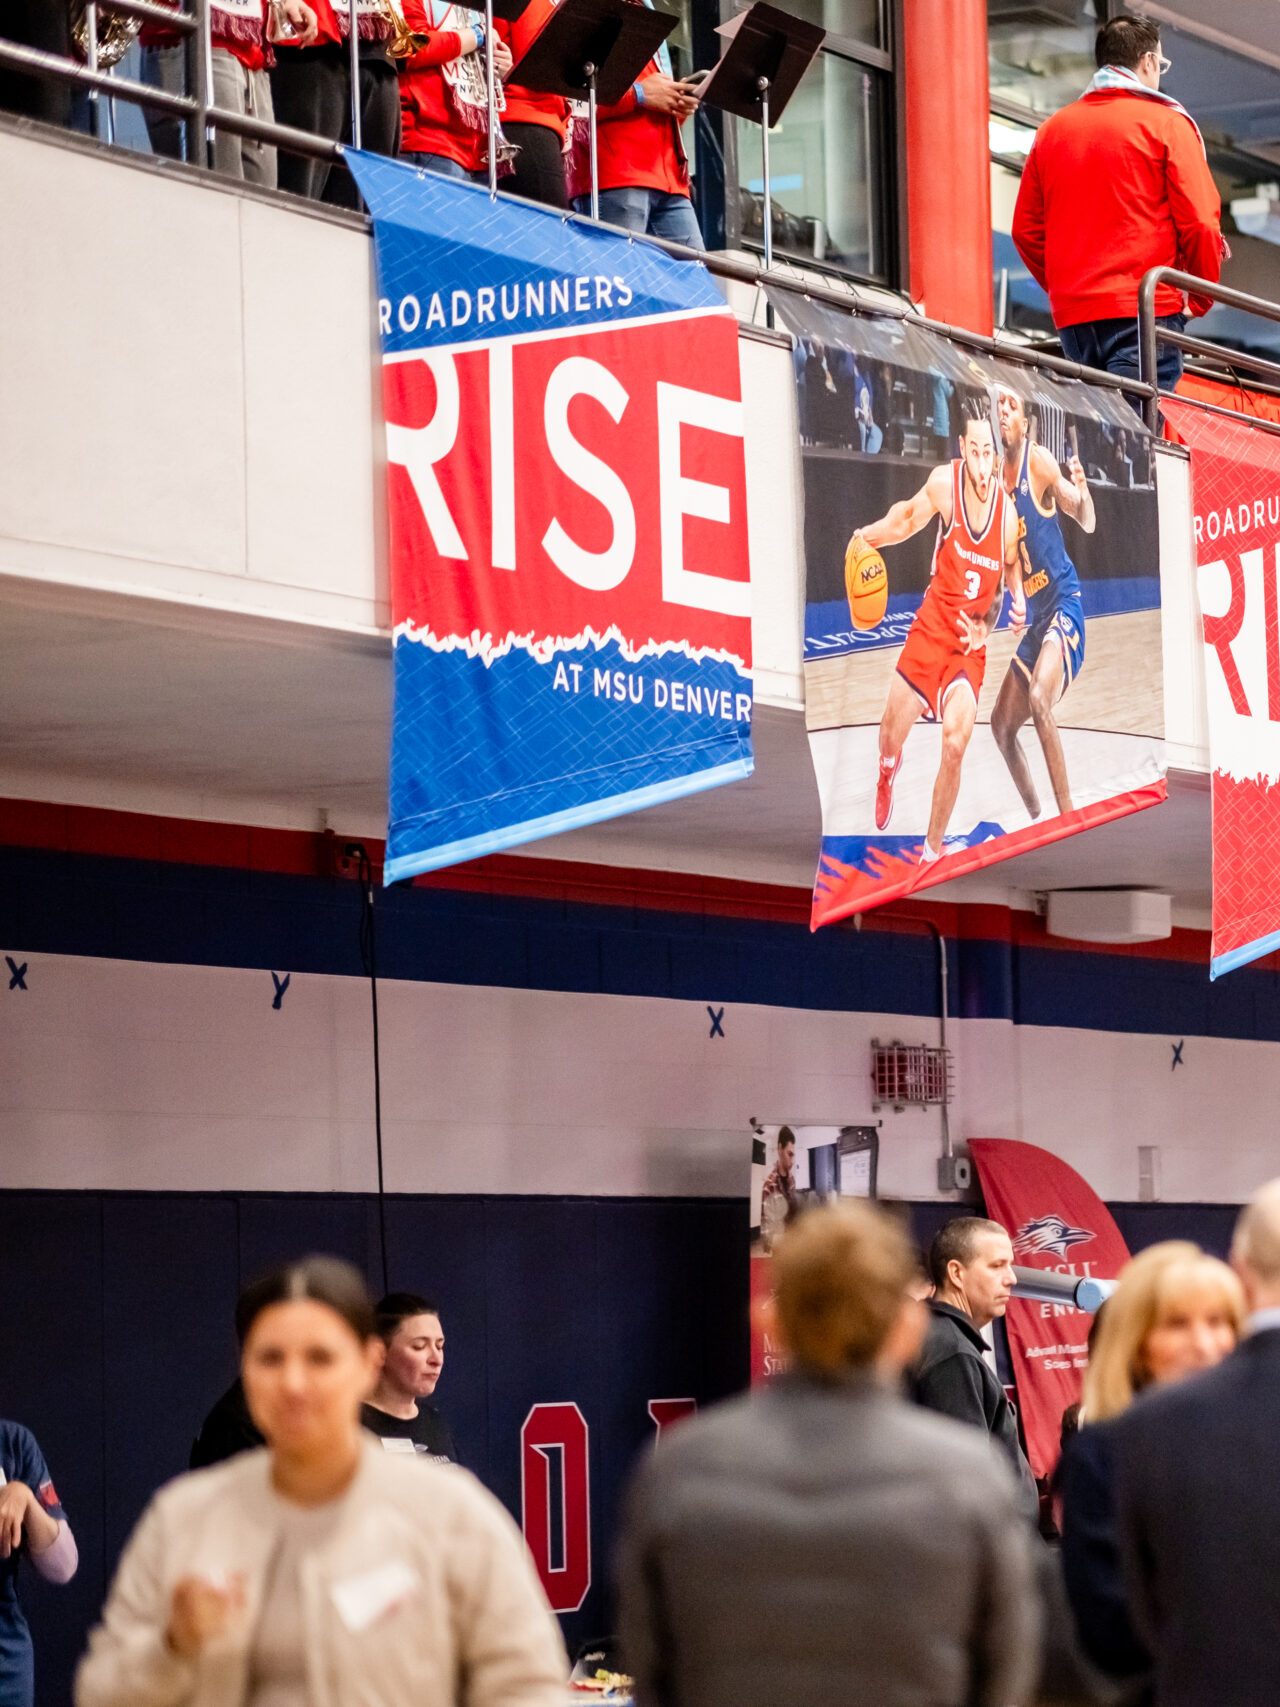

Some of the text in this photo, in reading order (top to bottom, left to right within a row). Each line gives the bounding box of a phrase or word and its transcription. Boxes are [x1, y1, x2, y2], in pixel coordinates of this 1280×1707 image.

[379, 276, 633, 335] ROADRUNNERS
[383, 345, 752, 618] RISE
[964, 569, 981, 600] 3
[553, 661, 752, 722] AT MSU DENVER
